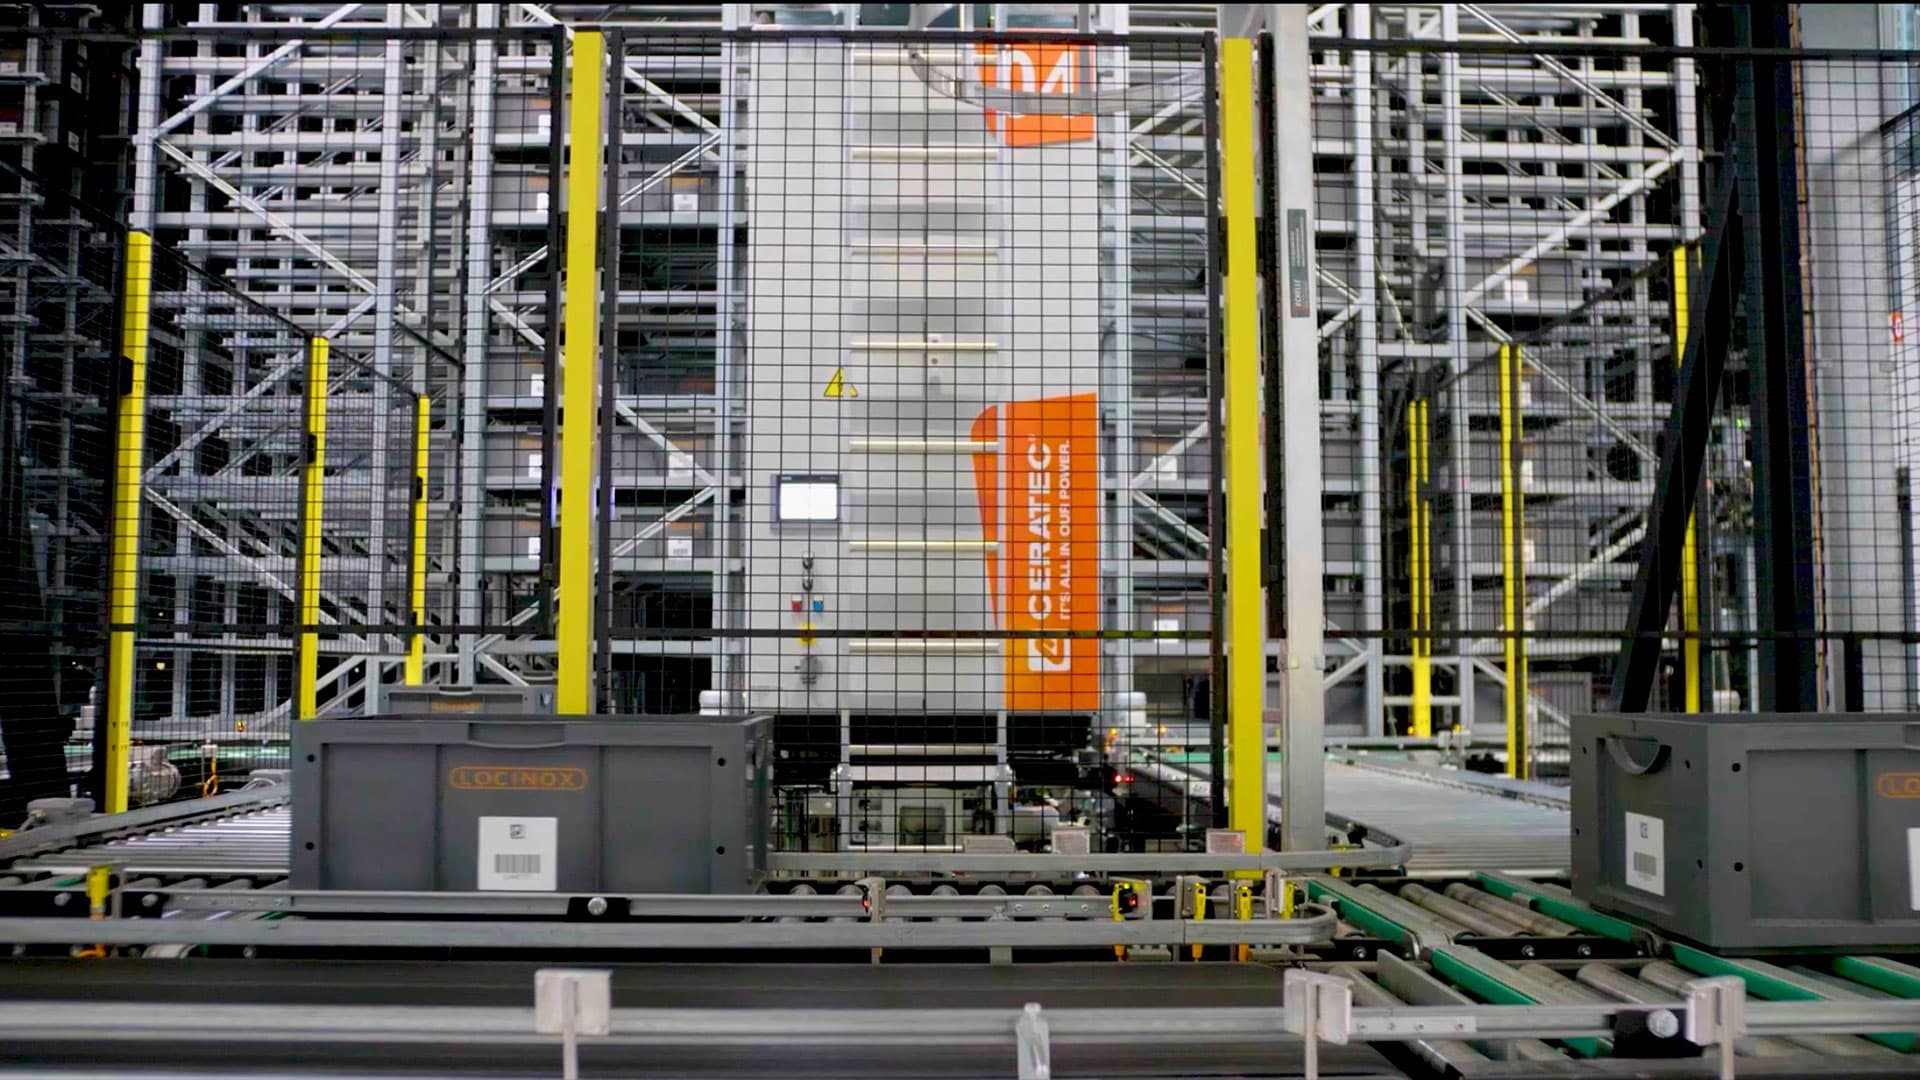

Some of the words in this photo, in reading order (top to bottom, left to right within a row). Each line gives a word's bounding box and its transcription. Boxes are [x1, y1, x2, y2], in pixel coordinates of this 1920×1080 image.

[1059, 439, 1071, 500] POWER.
[1027, 443, 1052, 620] CERATEC
[1059, 504, 1071, 537] OUR
[1059, 543, 1071, 556] IN
[1059, 560, 1071, 588] ALL
[1059, 592, 1071, 620] IT'S
[460, 771, 576, 787] LOCINOX
